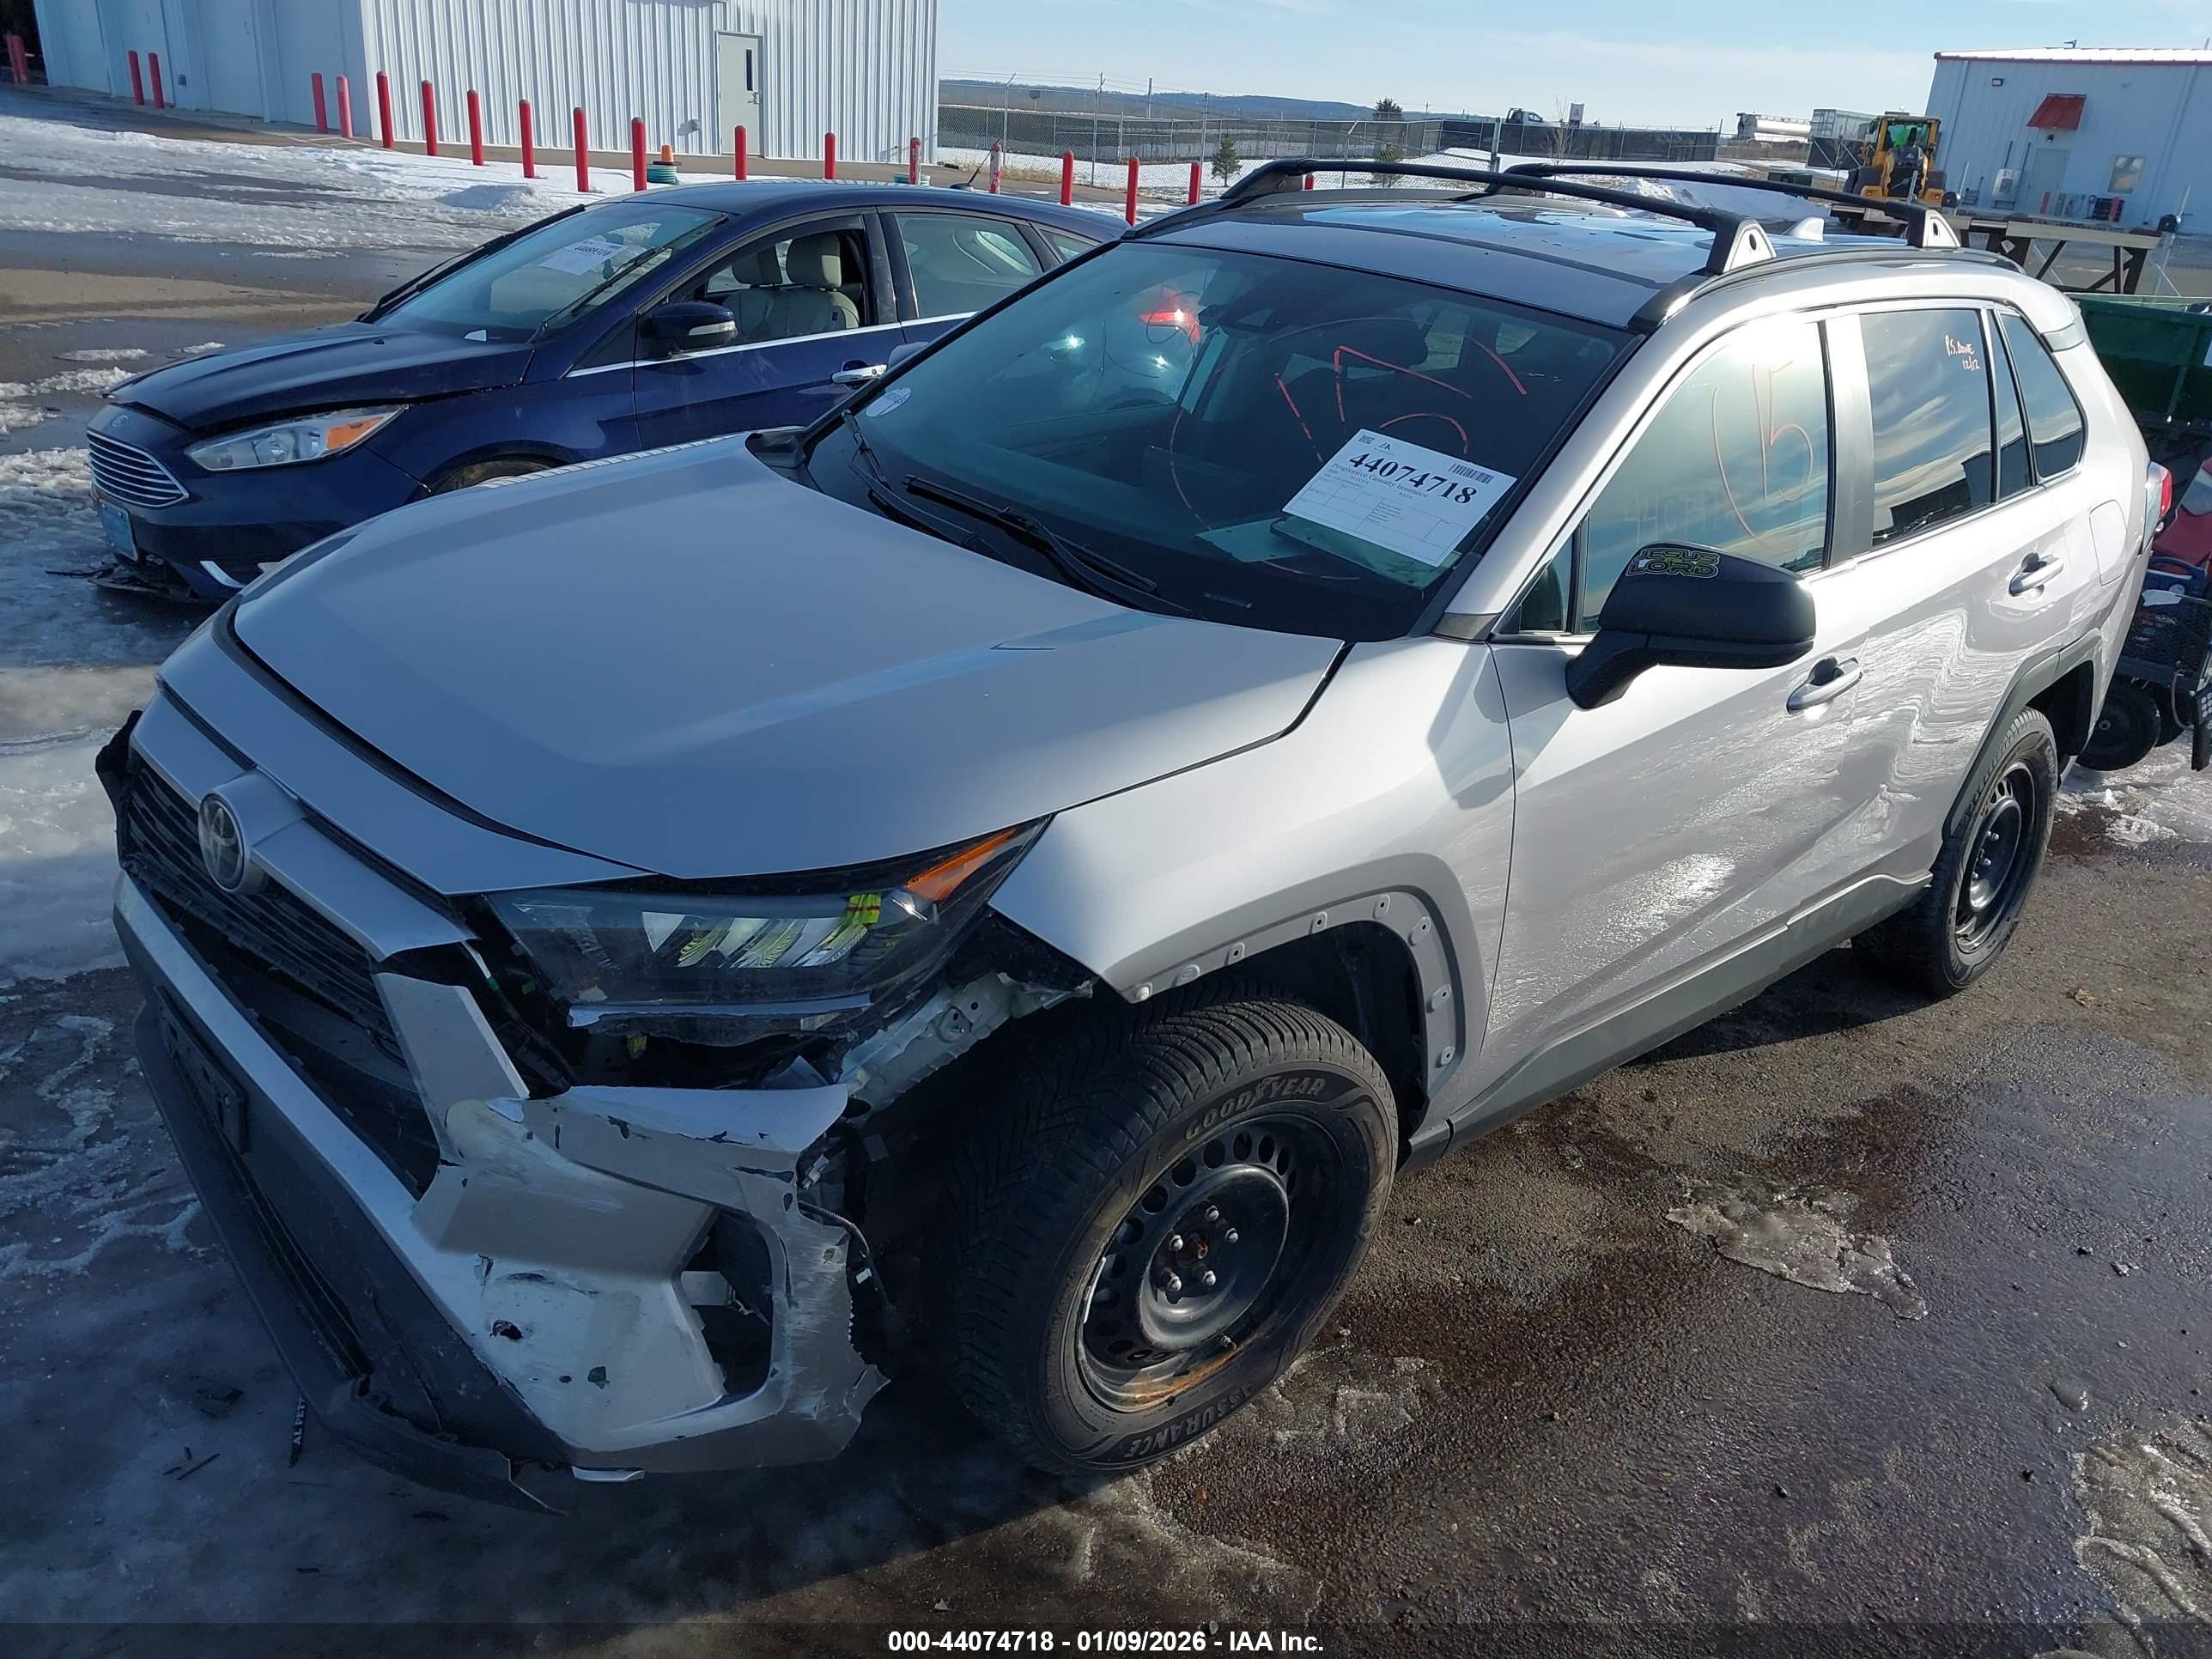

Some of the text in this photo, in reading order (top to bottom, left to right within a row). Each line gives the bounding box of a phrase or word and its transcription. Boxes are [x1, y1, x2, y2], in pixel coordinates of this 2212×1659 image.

[1332, 463, 1370, 478] Progressive
[1369, 472, 1395, 489] Casualty
[1396, 483, 1429, 499] Insurance
[1348, 453, 1478, 504] 44074718
[1627, 559, 1718, 578] LORD
[1640, 548, 1720, 564] JESUS
[1185, 1074, 1327, 1140] GOODYEAR
[1124, 1382, 1253, 1458] ASSURANCE
